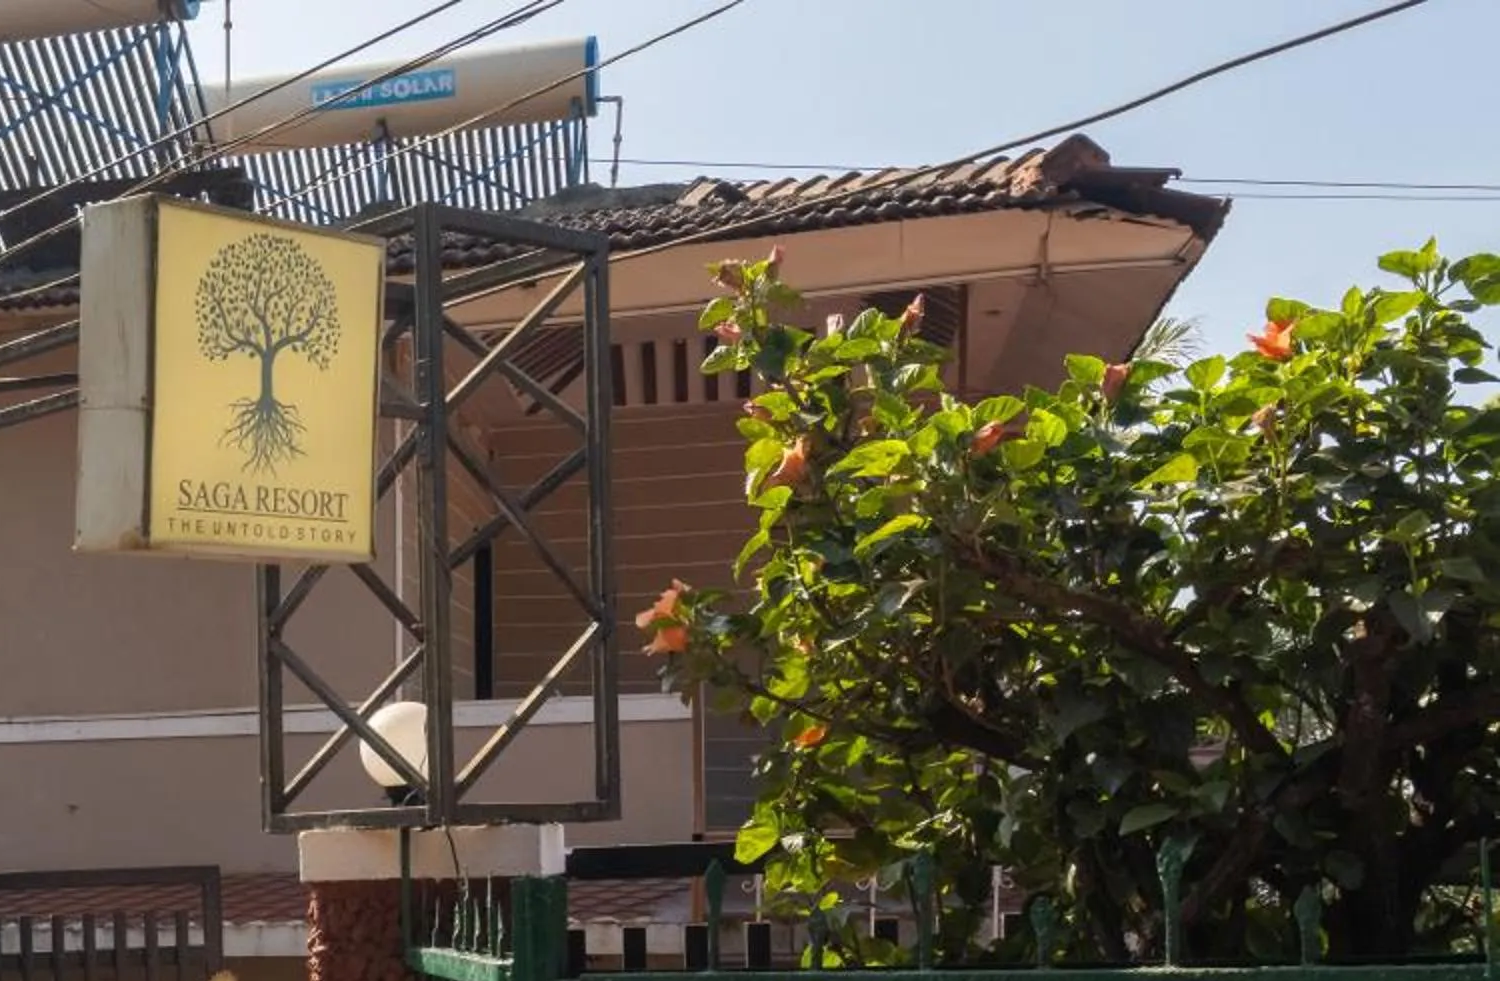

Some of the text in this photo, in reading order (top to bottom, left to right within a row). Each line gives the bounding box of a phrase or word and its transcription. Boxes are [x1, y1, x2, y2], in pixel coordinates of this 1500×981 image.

[379, 75, 453, 99] SOLAR
[178, 479, 349, 518] SAGA RESORT
[167, 517, 357, 543] THE UNTOLD STORY
